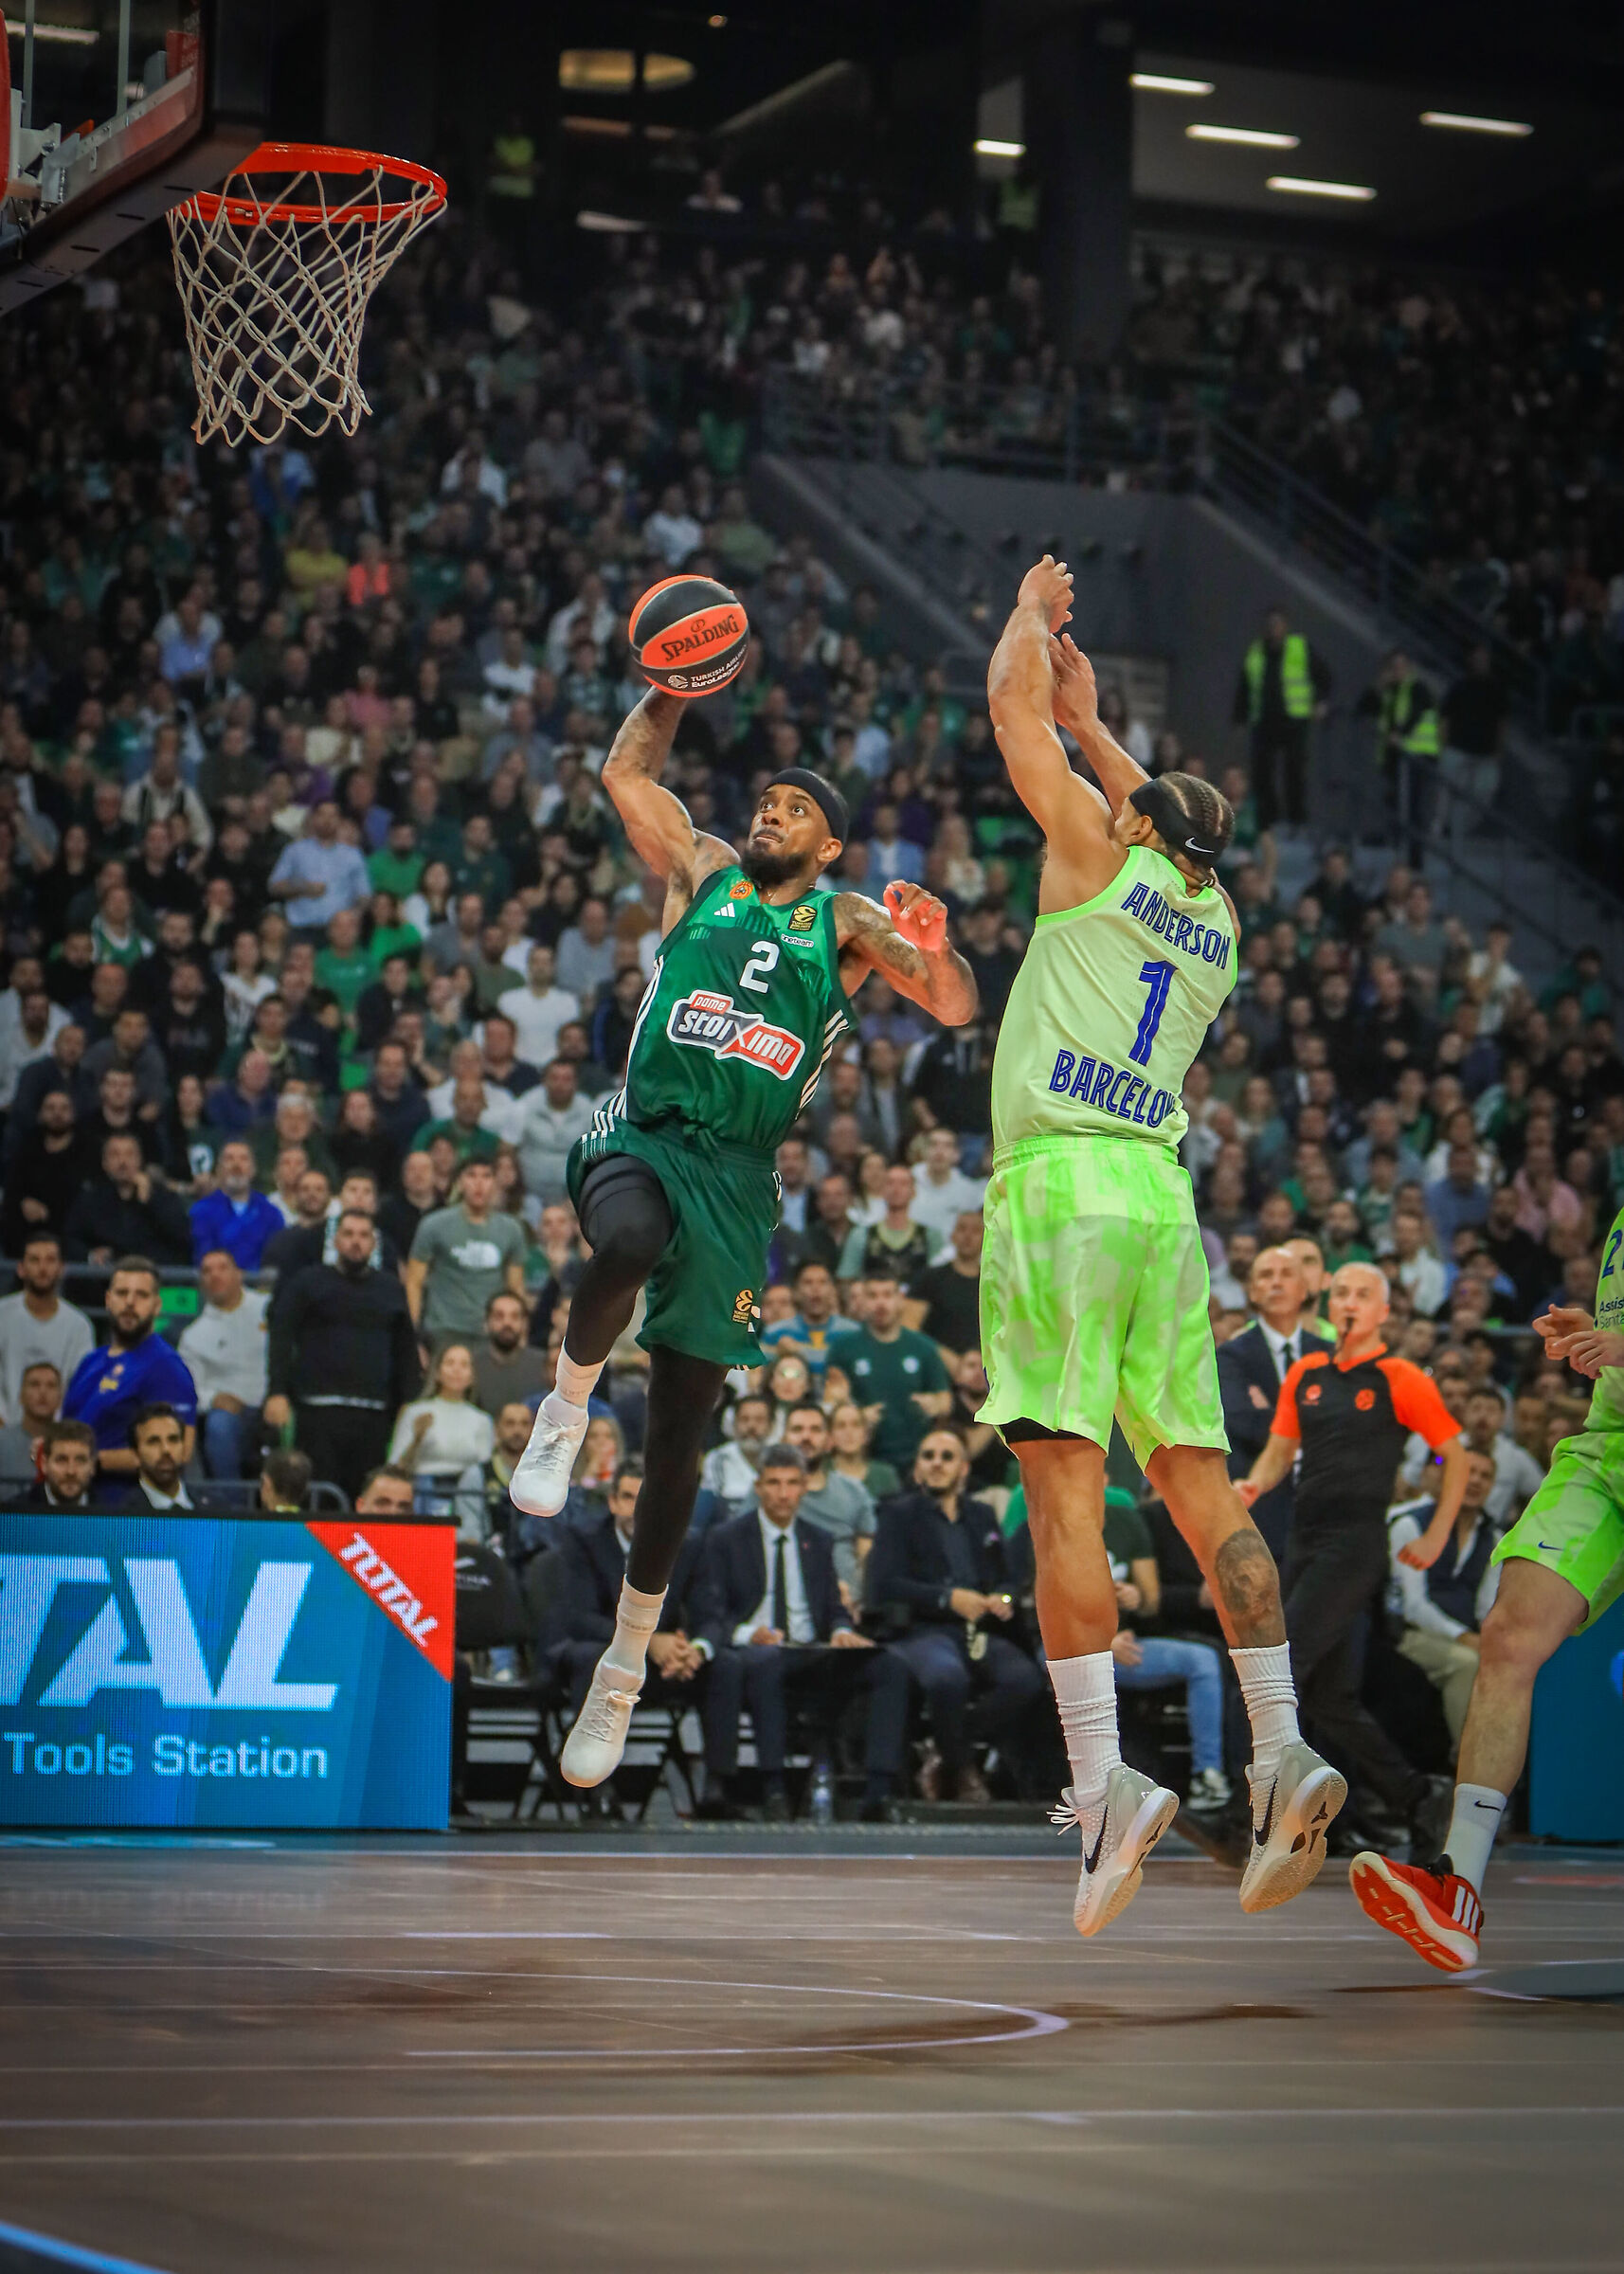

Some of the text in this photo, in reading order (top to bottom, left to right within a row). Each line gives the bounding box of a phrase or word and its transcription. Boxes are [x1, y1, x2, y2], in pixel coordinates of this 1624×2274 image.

[661, 614, 739, 661] SPALDING
[691, 666, 725, 682] TURKISH
[1121, 882, 1231, 969] ANDERSON
[739, 941, 780, 993] 2
[694, 996, 727, 1011] pame
[1128, 960, 1180, 1067] 1
[1601, 1229, 1624, 1279] 2
[1598, 1296, 1624, 1314] Assis
[339, 1532, 438, 1648] TOTAL
[3, 1732, 329, 1778] Tools Station
